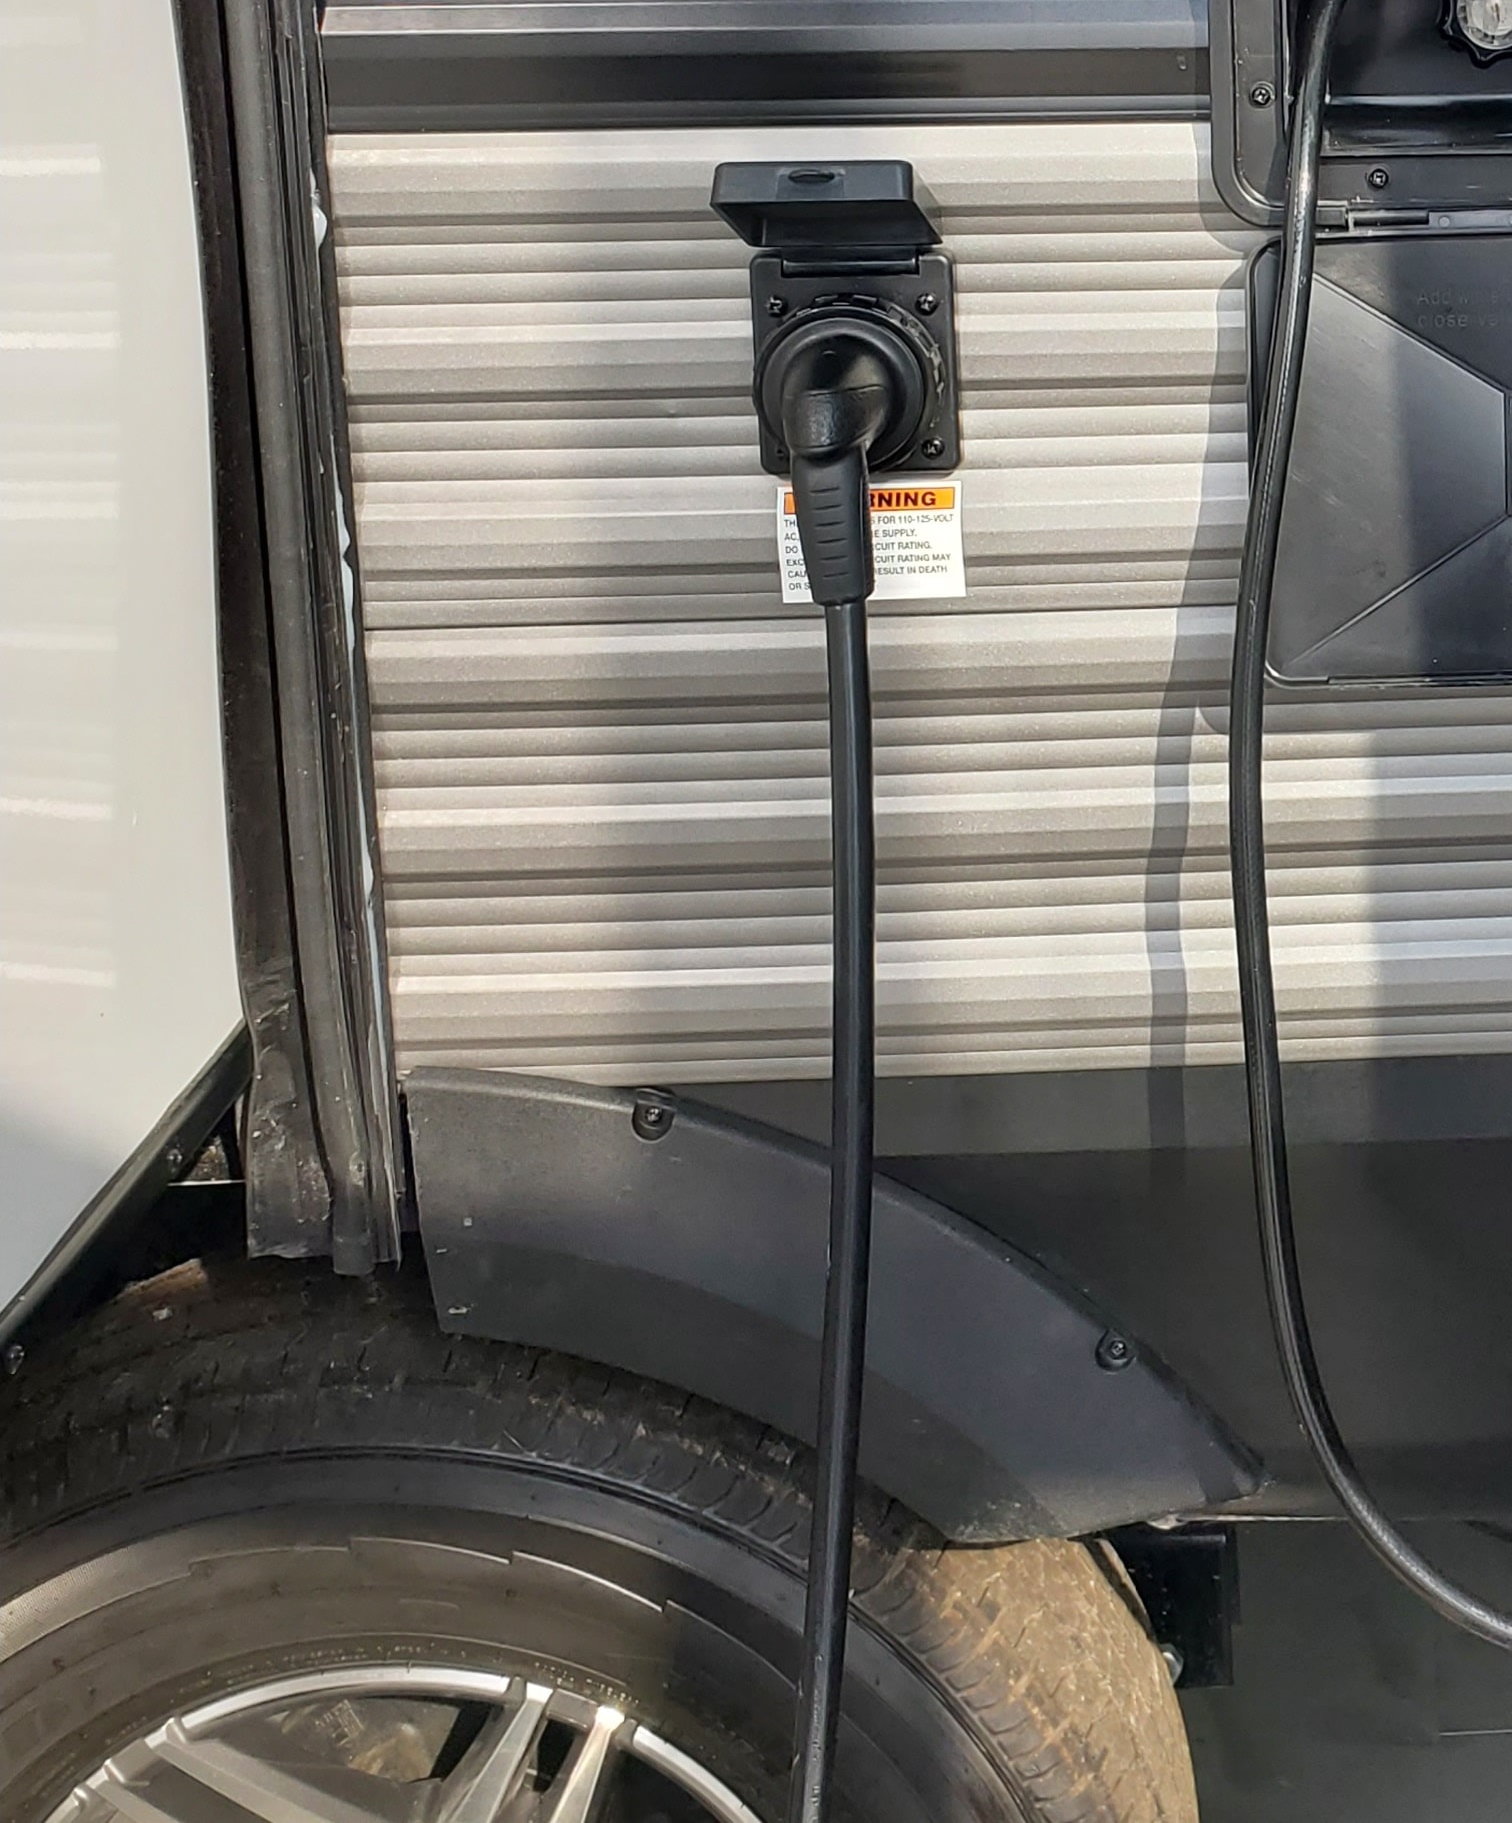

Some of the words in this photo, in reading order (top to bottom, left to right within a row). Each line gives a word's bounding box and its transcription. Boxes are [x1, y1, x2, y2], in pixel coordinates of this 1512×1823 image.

[878, 515, 896, 524] FOR
[882, 528, 917, 537] SUPPLY.
[785, 546, 798, 554] DO
[897, 541, 932, 550] RATING.
[897, 554, 930, 563] RATING
[932, 553, 951, 561] MAY
[876, 566, 904, 575] ESULT
[907, 566, 917, 574] IN
[918, 565, 948, 574] DEATH
